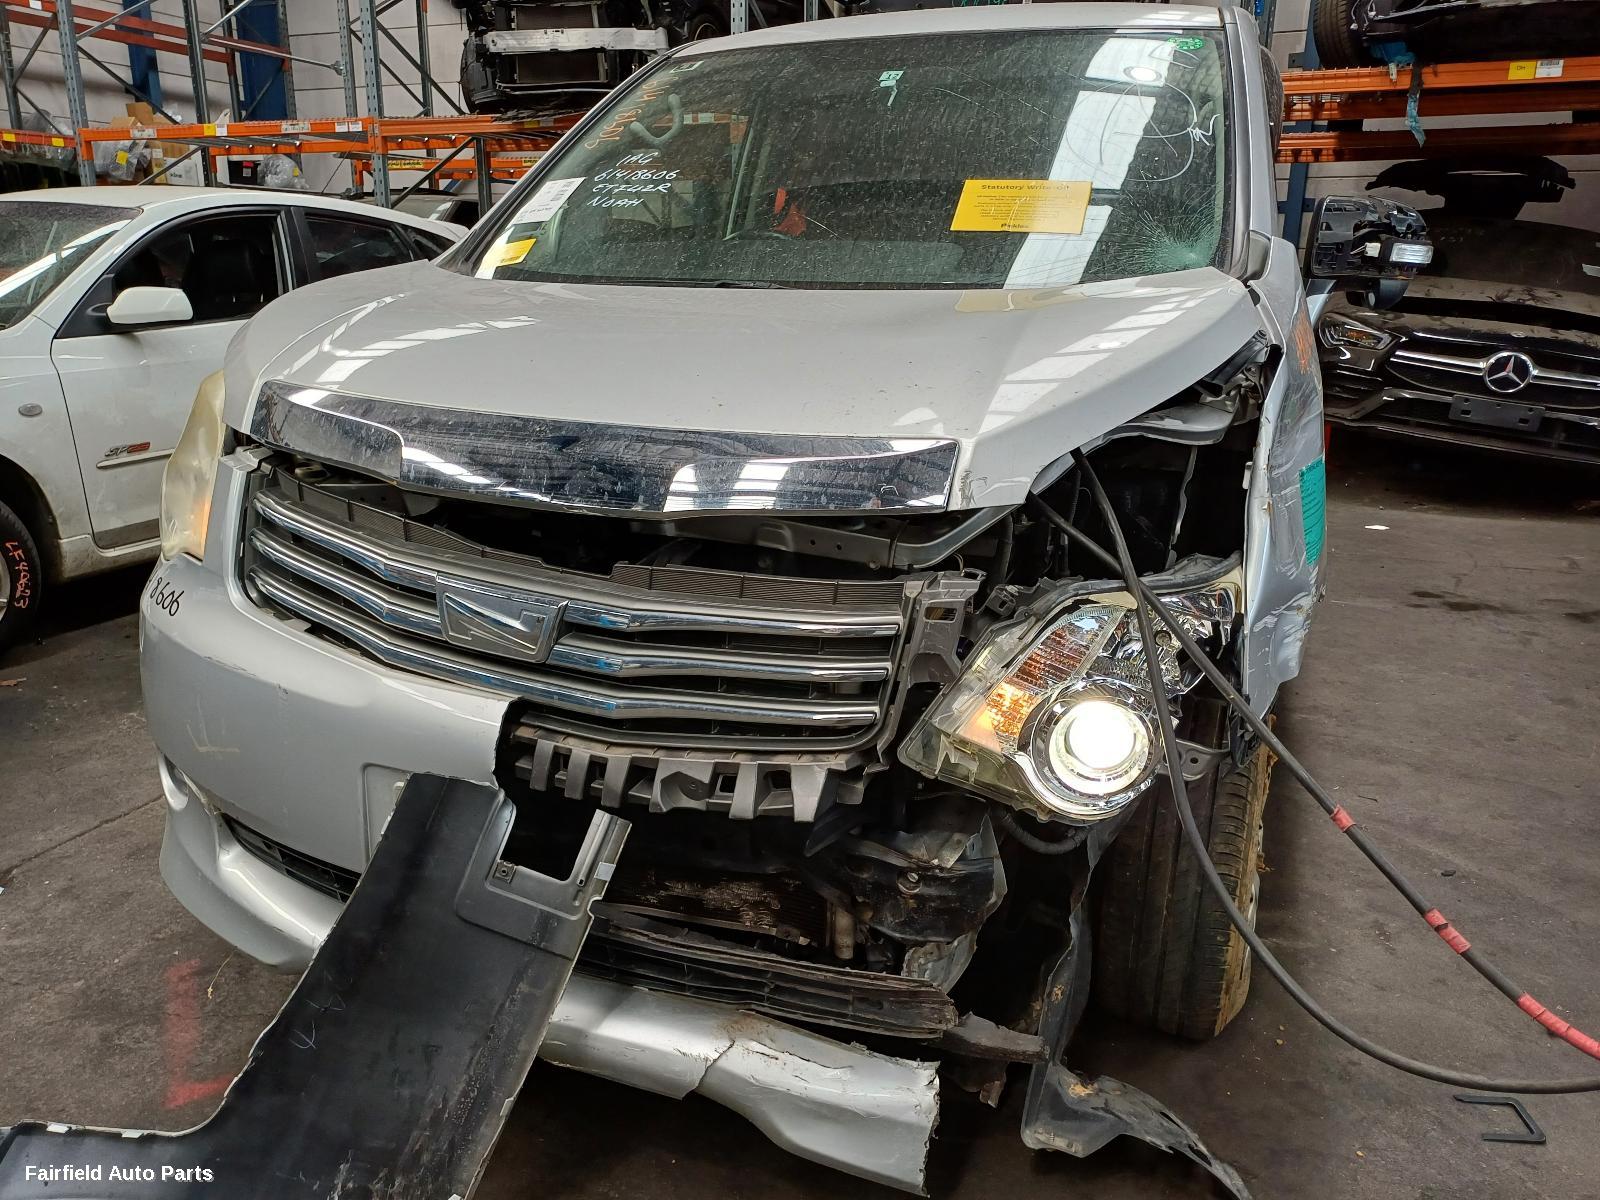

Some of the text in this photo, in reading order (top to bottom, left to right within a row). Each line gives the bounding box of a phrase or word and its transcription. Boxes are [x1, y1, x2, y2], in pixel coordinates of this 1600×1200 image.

[615, 152, 659, 166] IAG
[594, 168, 681, 181] 61418606
[586, 196, 645, 208] NOAH
[150, 576, 185, 617] 8606
